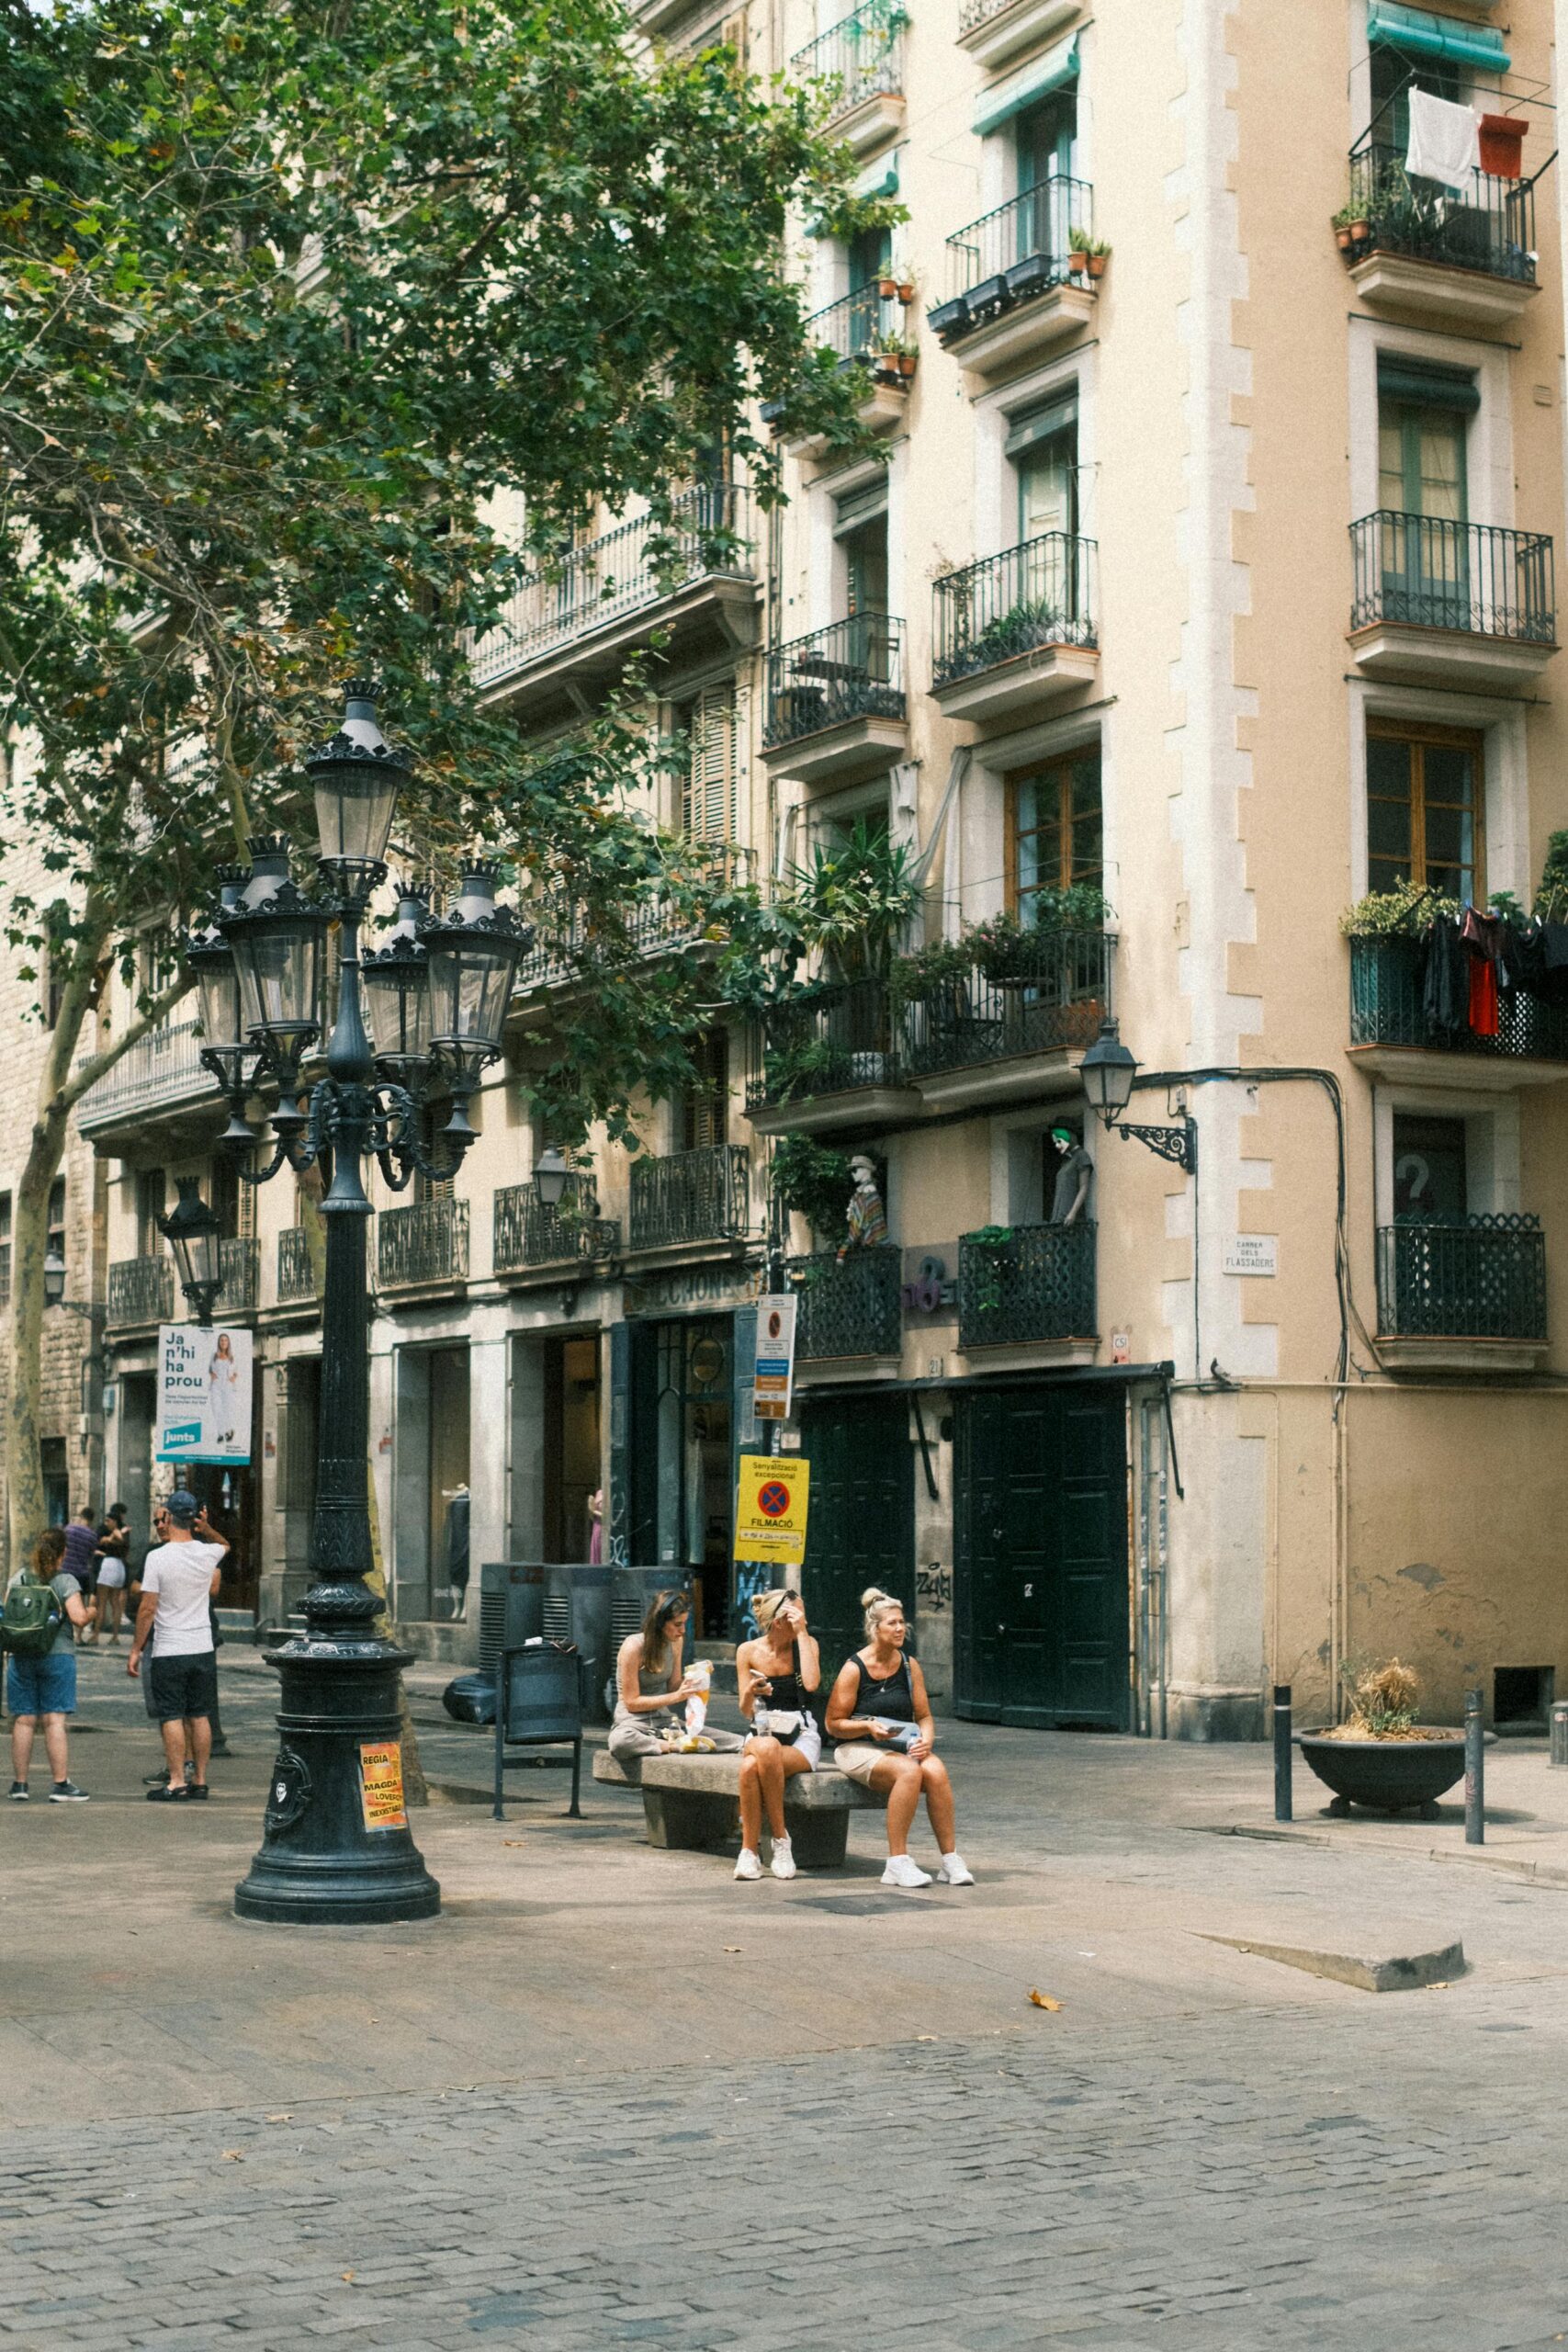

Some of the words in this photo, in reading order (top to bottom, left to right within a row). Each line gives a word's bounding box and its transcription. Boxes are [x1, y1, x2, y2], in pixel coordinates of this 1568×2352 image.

[1225, 1257, 1274, 1268] FLASSADERS
[166, 1332, 184, 1344] Ja
[165, 1346, 195, 1360] n'hi
[165, 1360, 184, 1373] ha
[165, 1376, 202, 1389] prou
[165, 1431, 196, 1444] junts
[752, 1462, 797, 1472] Senyalització
[754, 1472, 795, 1480] excepcional
[751, 1518, 794, 1529] FILMACIÓ
[363, 1755, 389, 1765] REGIA
[364, 1780, 398, 1792] MAGDA
